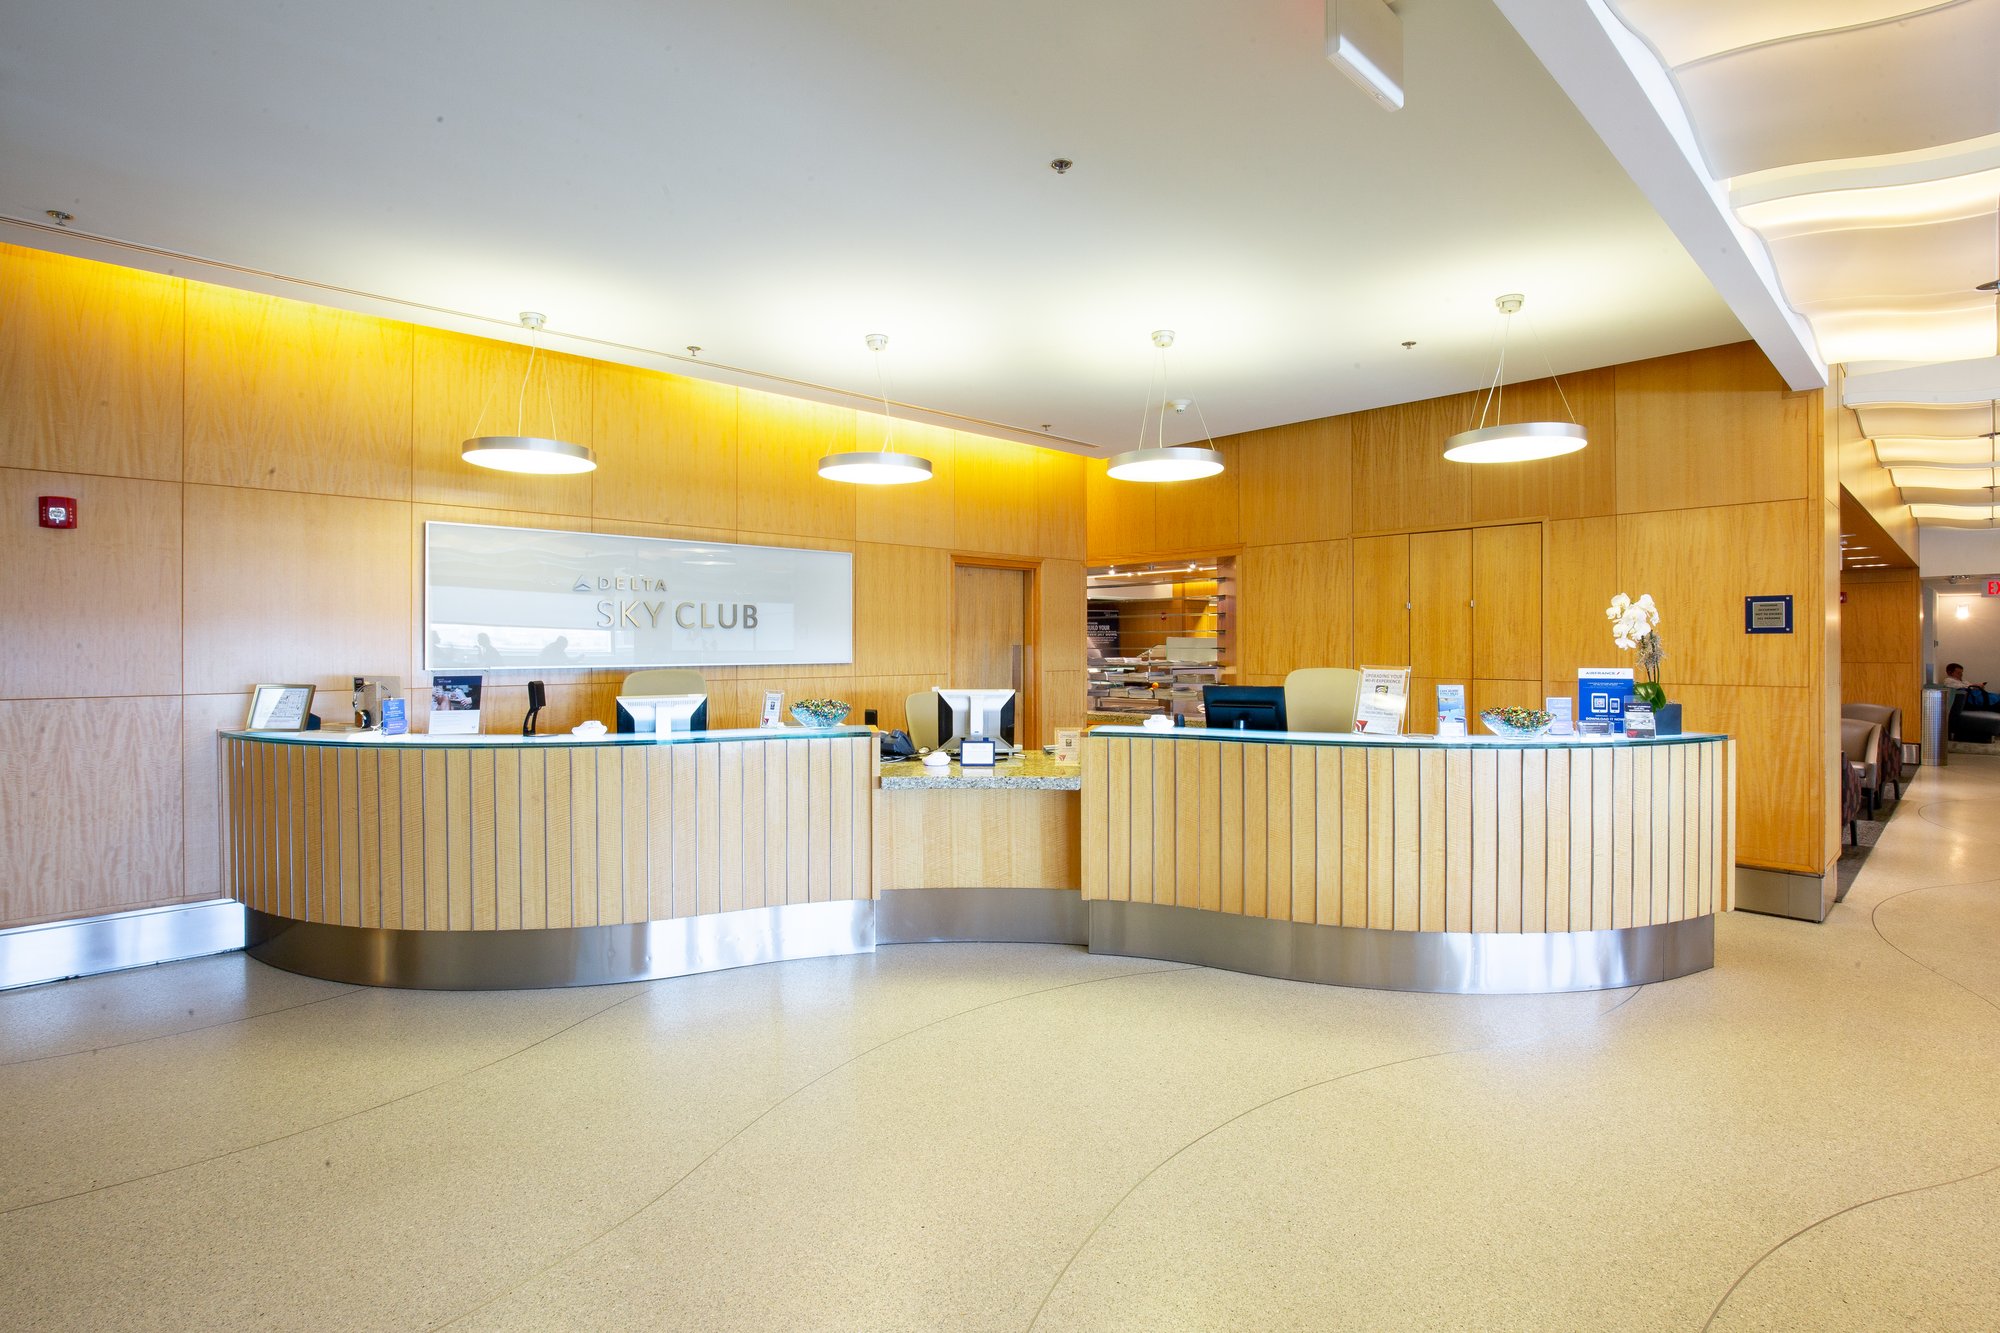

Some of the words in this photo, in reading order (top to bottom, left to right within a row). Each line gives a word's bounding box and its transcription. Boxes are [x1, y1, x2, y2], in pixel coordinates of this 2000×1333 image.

[597, 576, 668, 592] DELTA
[597, 600, 665, 629] SKY
[675, 601, 759, 630] CLUB
